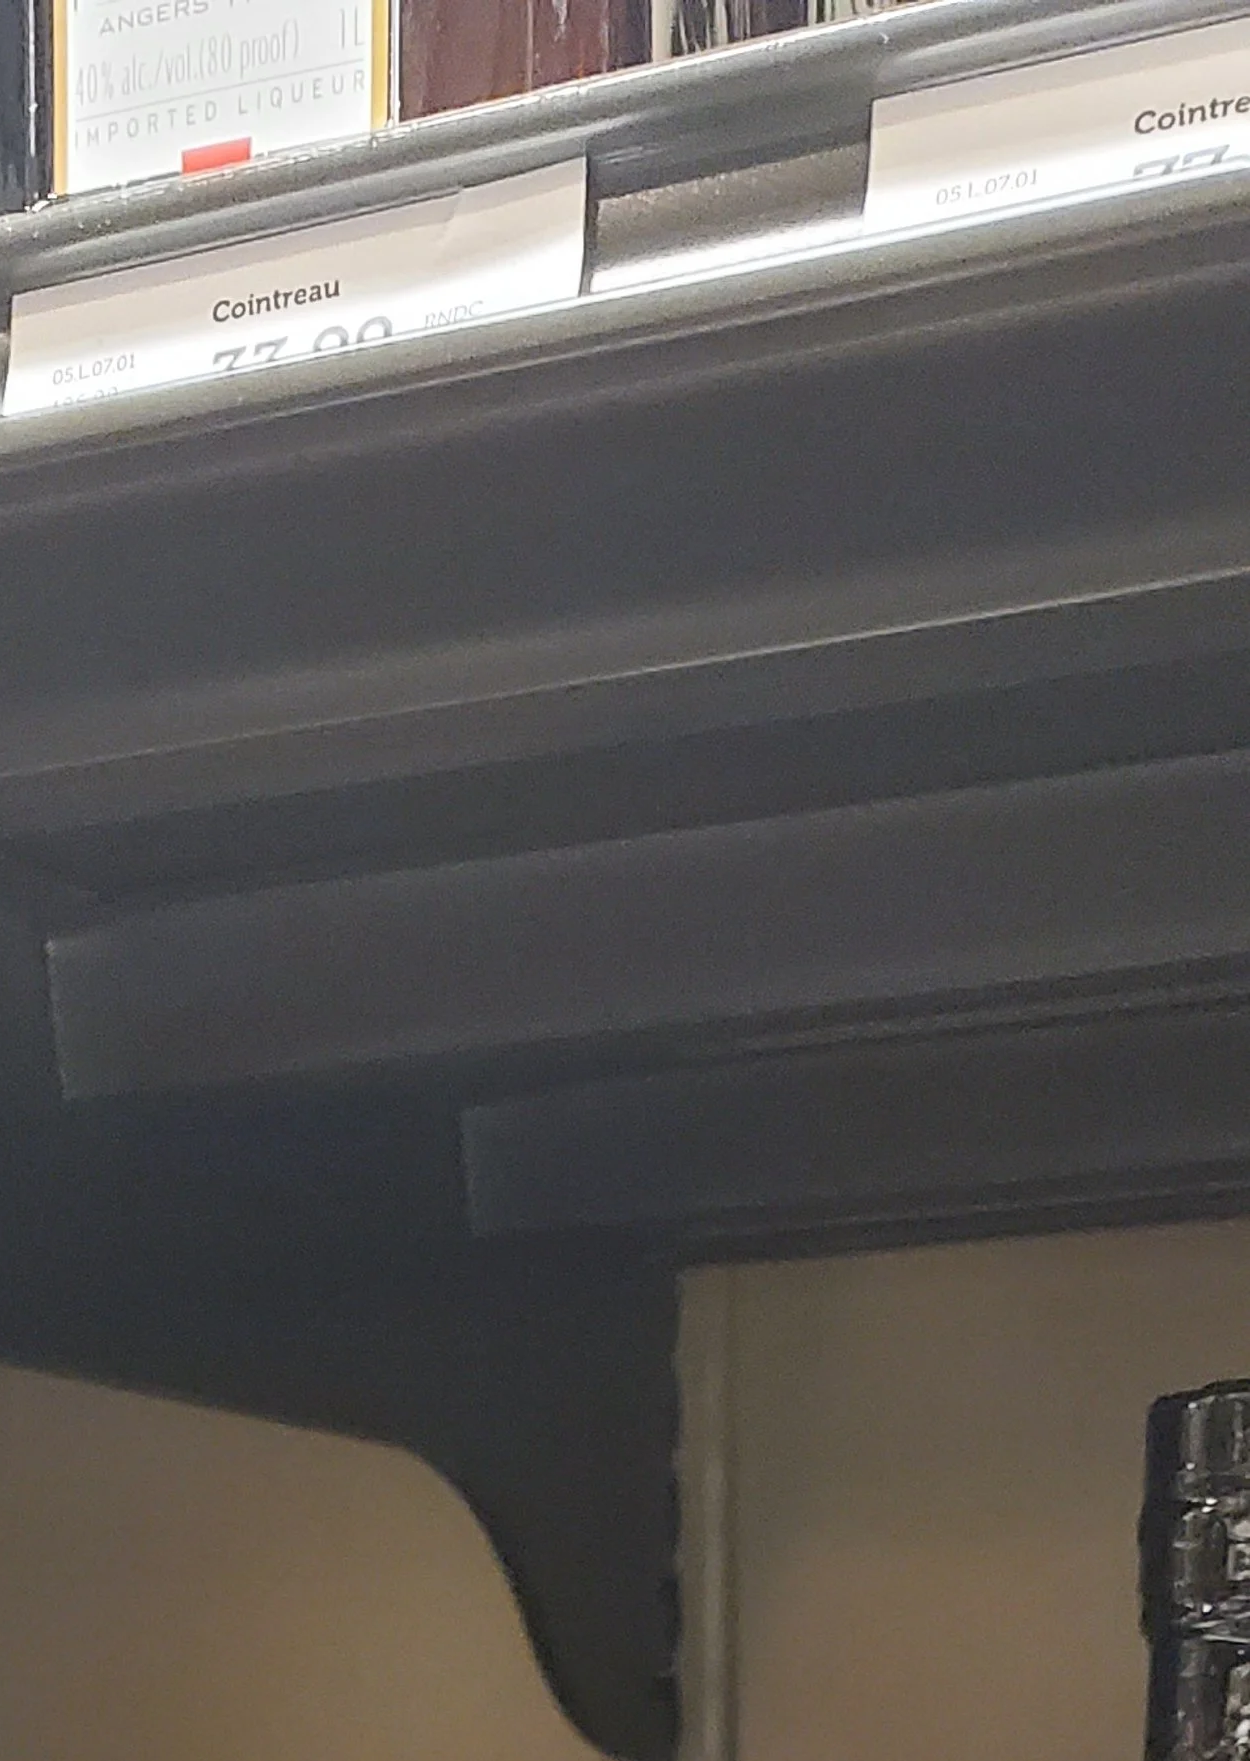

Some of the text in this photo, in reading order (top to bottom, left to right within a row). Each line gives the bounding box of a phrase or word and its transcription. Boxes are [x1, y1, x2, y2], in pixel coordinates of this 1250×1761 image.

[100, 0, 210, 36] ANGERS
[75, 62, 115, 107] 40%
[74, 70, 366, 150] IMPORTED LIQUEUR
[212, 278, 342, 324] Cointreau
